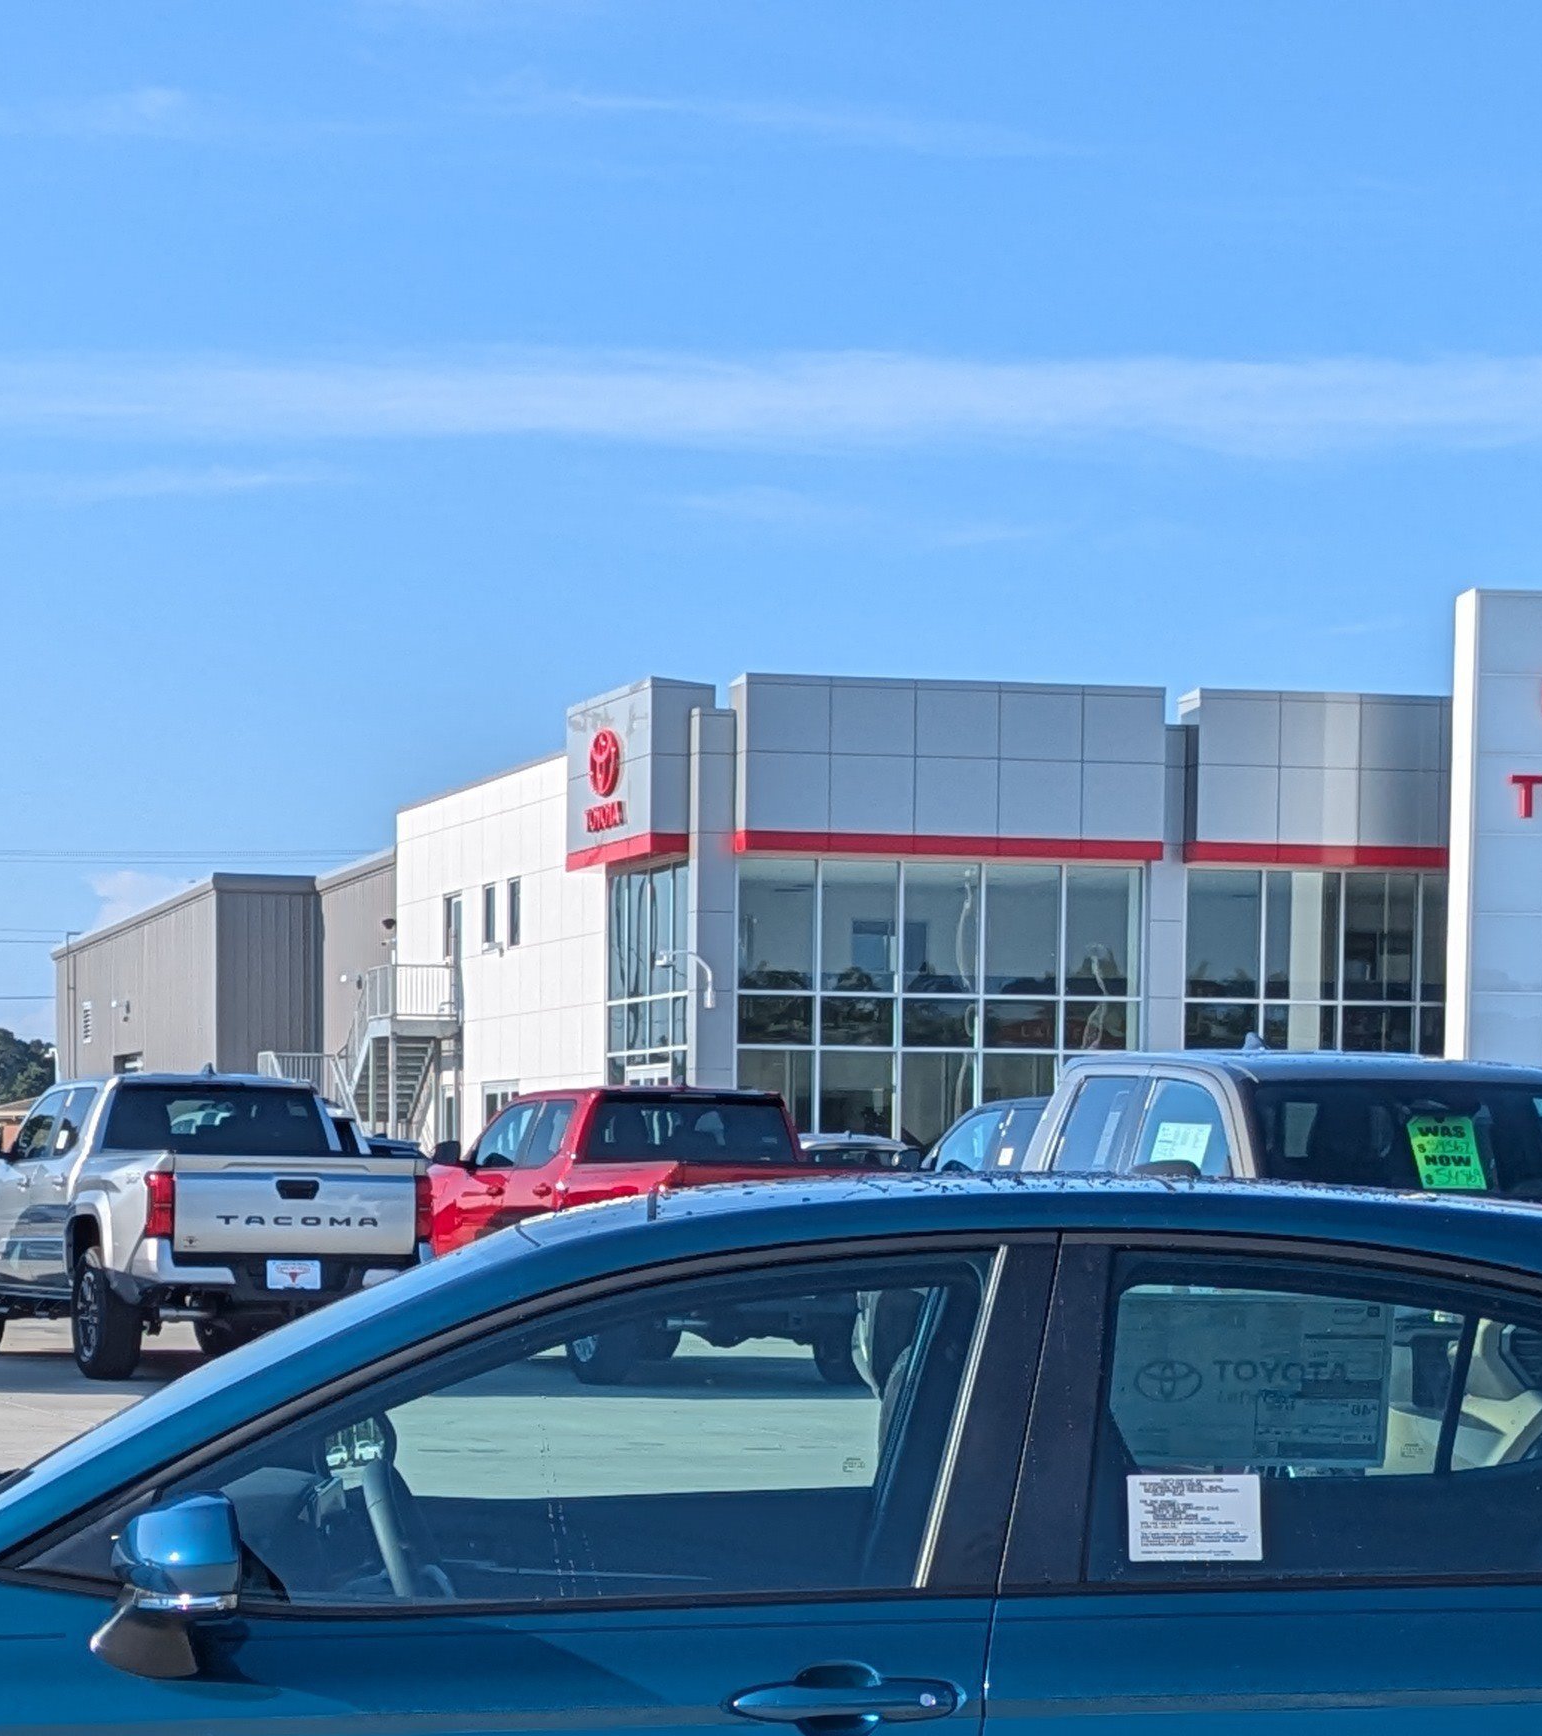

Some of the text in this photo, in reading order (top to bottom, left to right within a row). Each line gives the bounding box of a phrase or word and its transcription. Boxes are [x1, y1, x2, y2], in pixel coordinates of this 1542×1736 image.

[1417, 1126, 1466, 1138] WAS
[1424, 1155, 1472, 1167] NOW
[216, 1214, 379, 1228] TACOMA
[1212, 1359, 1349, 1383] TOYOTA
